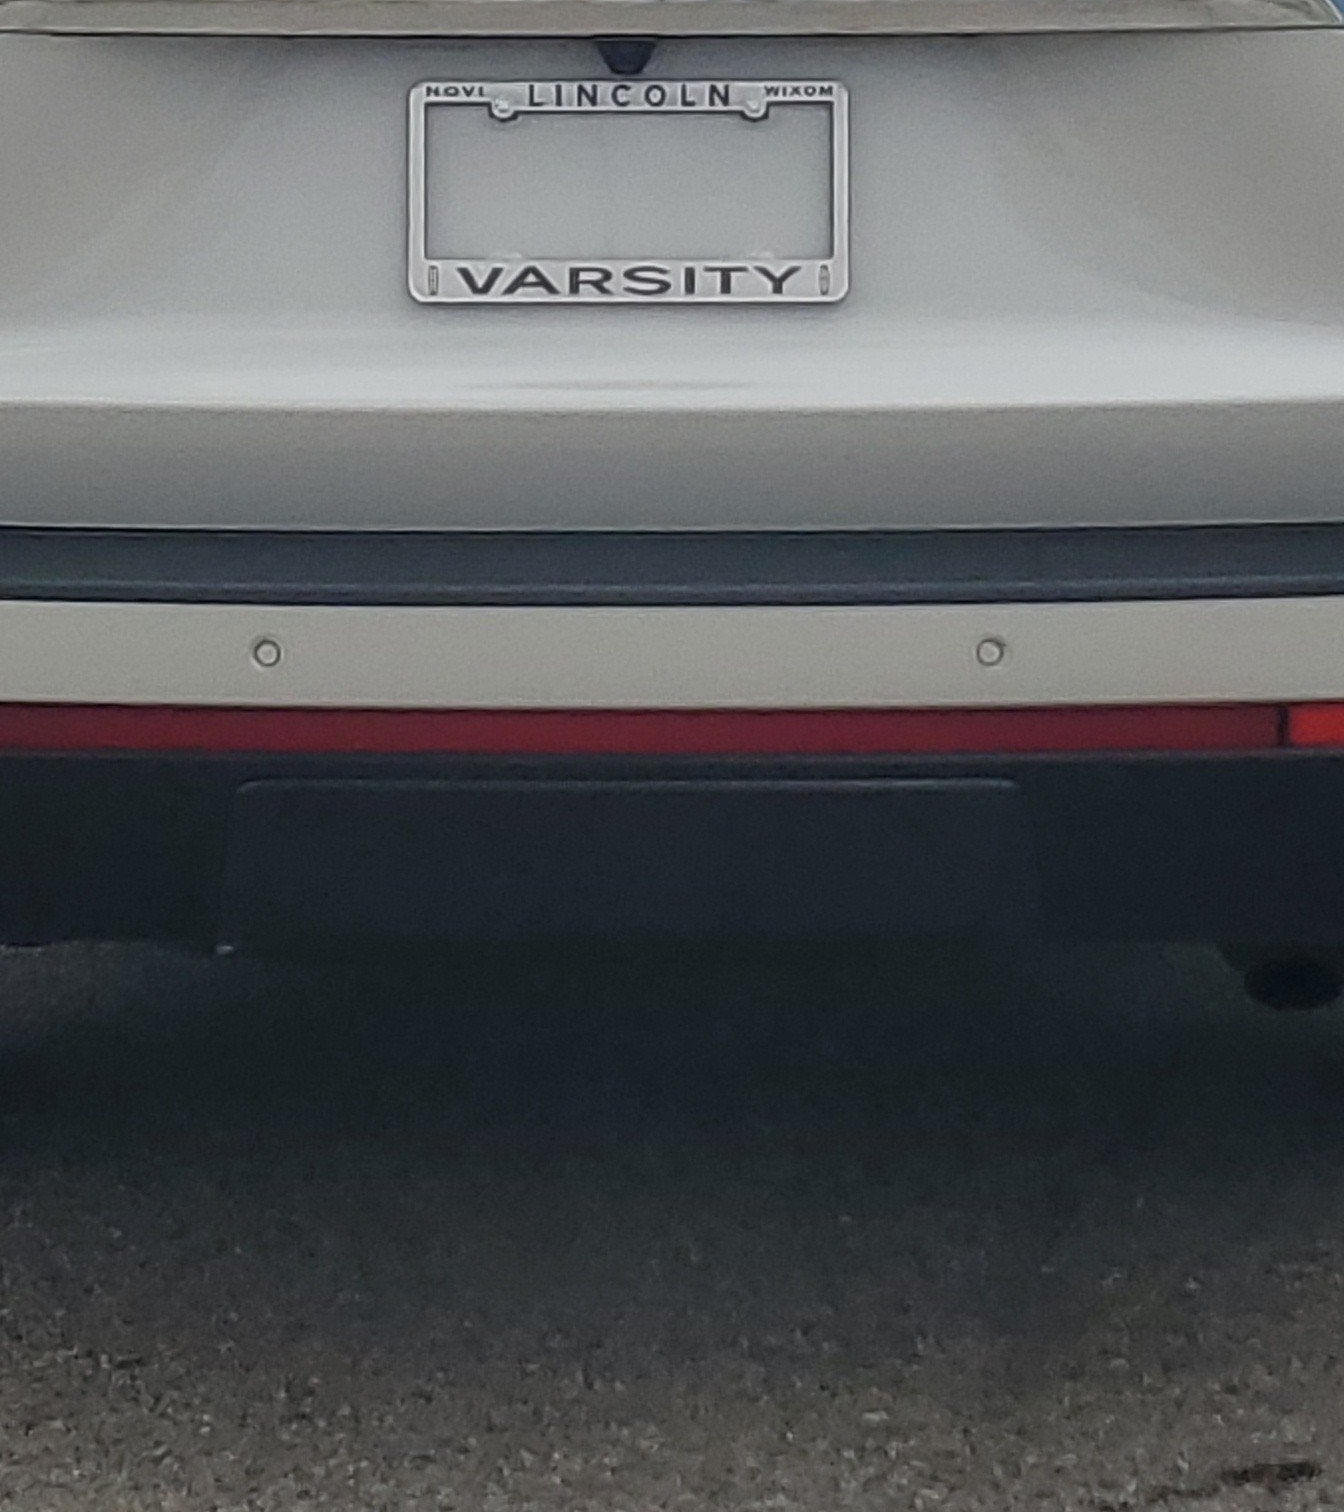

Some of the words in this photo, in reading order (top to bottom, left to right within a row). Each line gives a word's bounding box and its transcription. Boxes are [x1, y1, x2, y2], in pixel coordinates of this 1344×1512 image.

[425, 85, 486, 97] NOVI
[528, 83, 730, 107] LINCOLN
[764, 85, 834, 96] WIXOM
[456, 266, 802, 295] VARSITY
